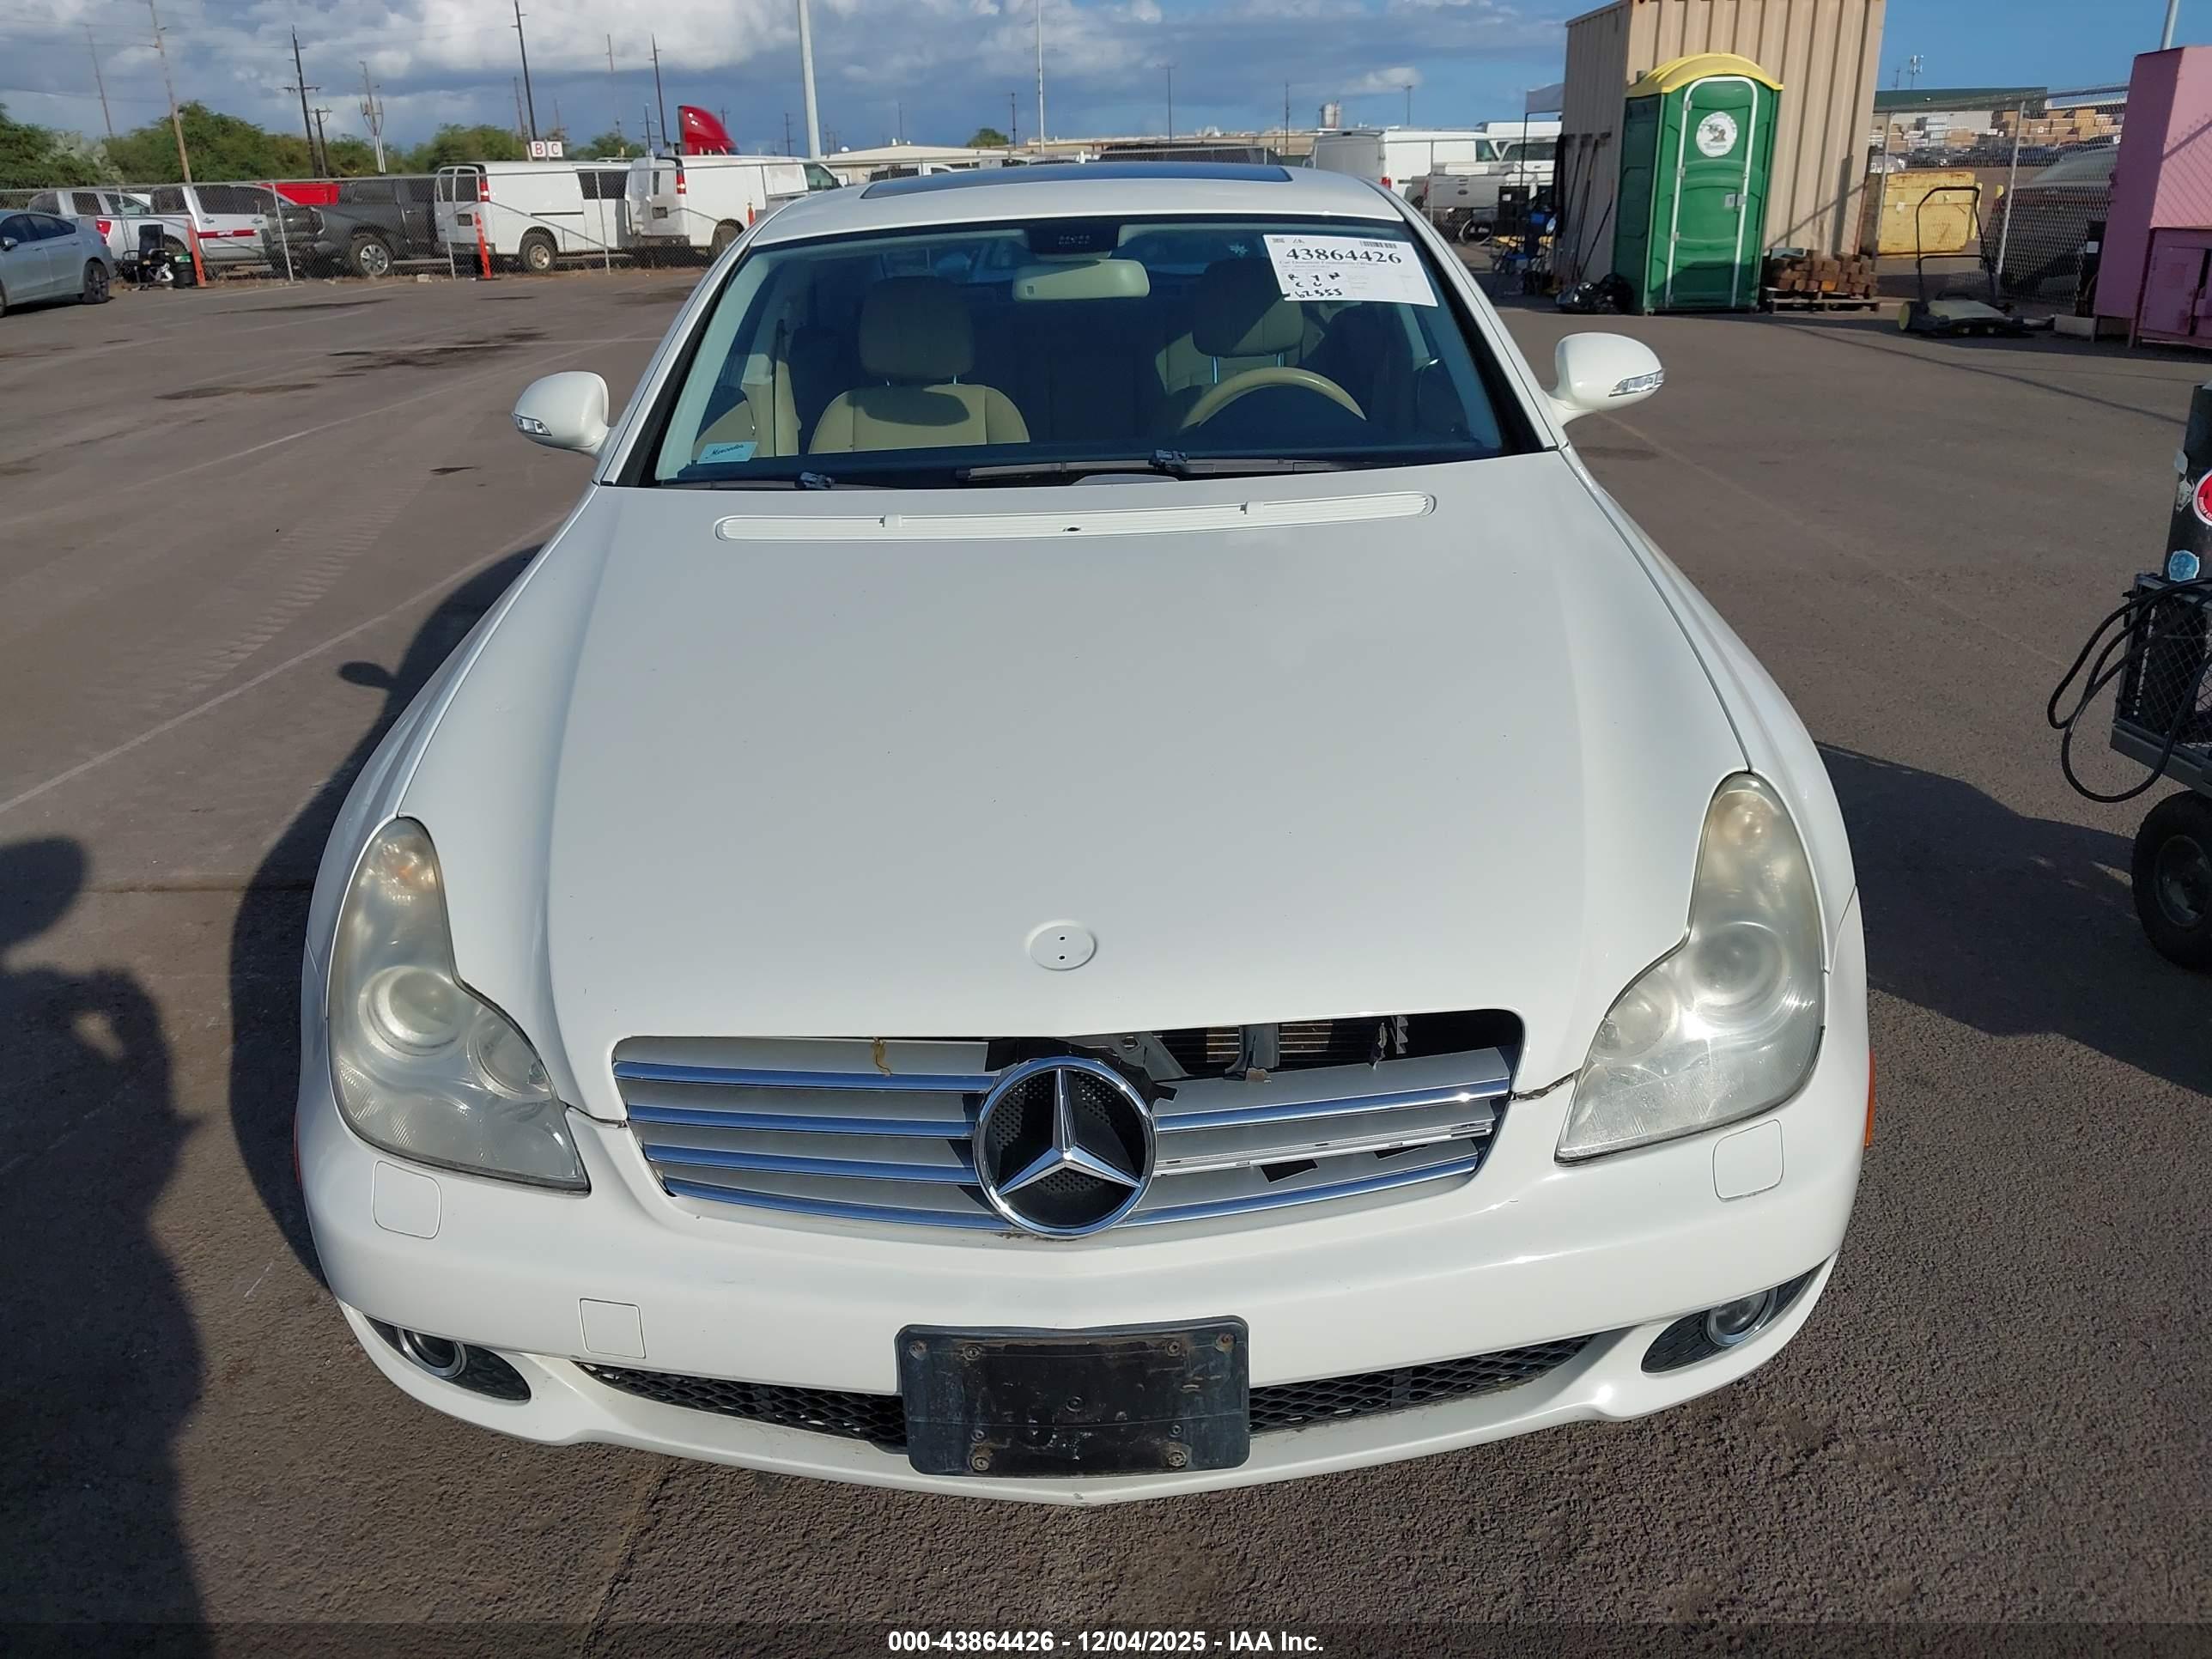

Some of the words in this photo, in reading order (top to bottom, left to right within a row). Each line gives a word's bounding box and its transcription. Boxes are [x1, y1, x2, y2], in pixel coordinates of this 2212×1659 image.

[535, 143, 544, 155] B
[551, 143, 559, 155] C
[1286, 248, 1402, 264] 43864426
